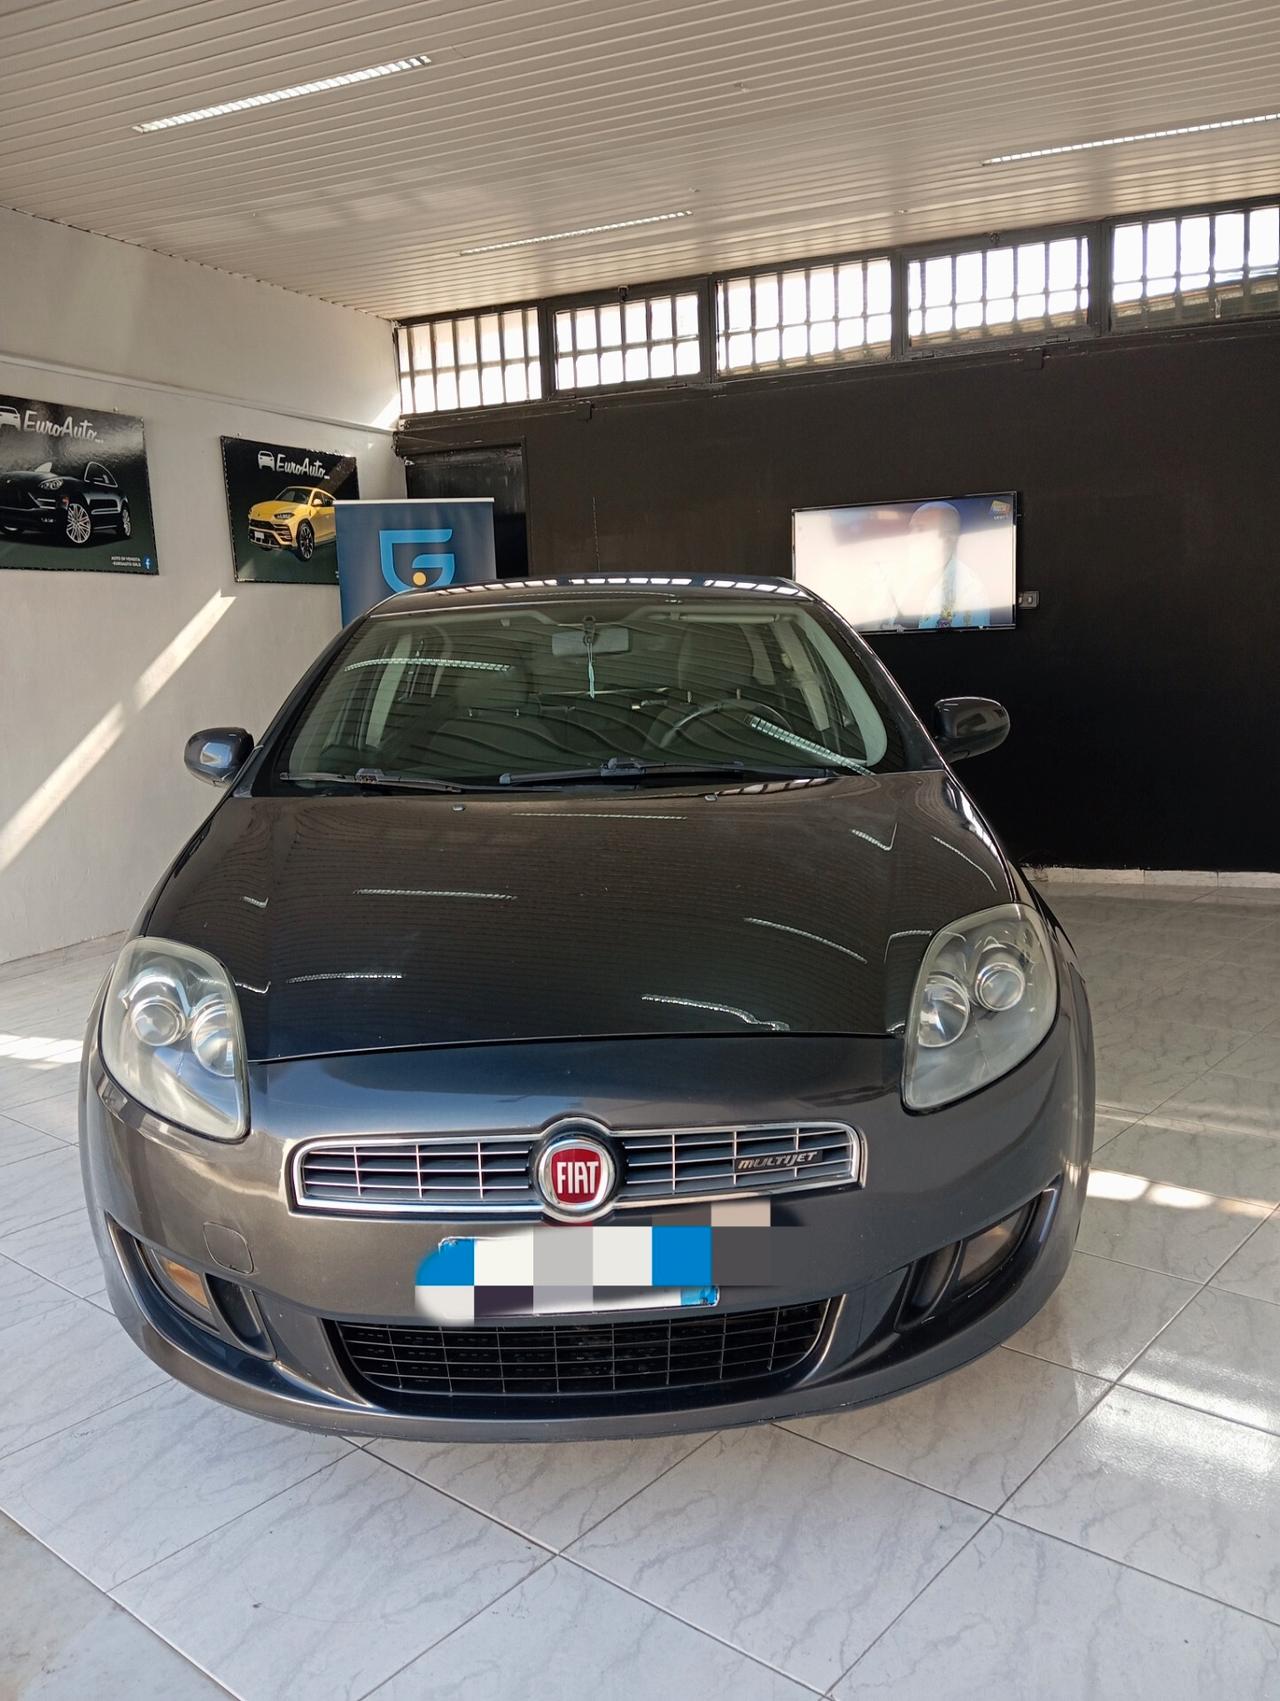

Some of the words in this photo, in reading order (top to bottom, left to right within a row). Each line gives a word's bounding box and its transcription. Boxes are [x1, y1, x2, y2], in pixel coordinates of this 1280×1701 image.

[23, 410, 97, 440] EuroAuto
[276, 453, 326, 478] EuroAuto
[738, 1151, 818, 1169] MULTIJET
[557, 1161, 599, 1194] FIAT
